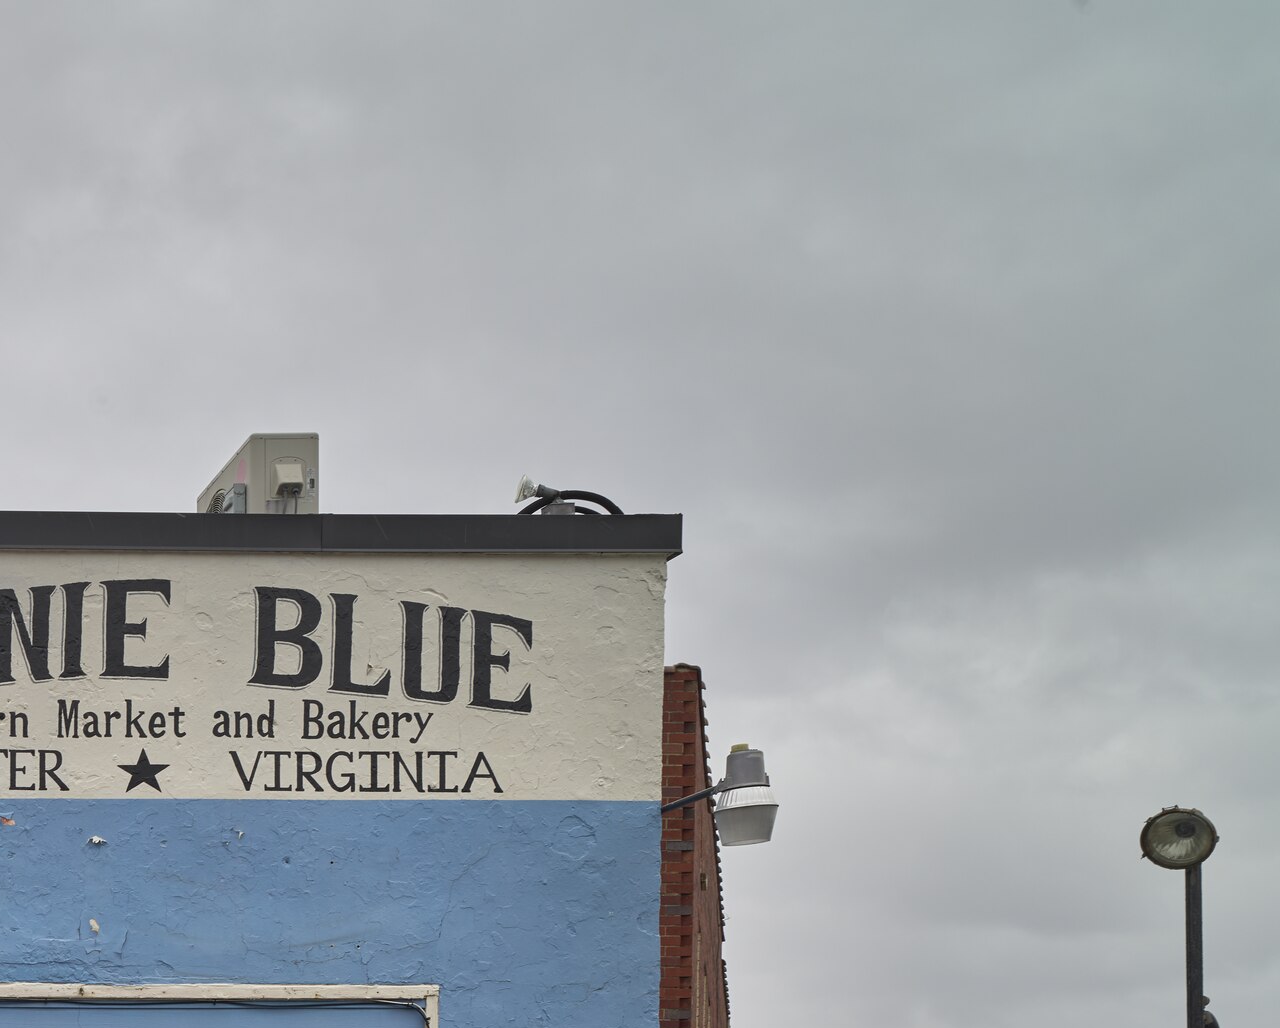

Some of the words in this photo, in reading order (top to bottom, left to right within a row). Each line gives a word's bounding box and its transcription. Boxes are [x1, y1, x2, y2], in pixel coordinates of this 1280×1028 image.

[246, 585, 534, 715] BLUE
[57, 699, 188, 740] Market
[211, 700, 277, 740] and
[303, 700, 434, 744] Bakery
[228, 750, 505, 794] VIRGINIA
